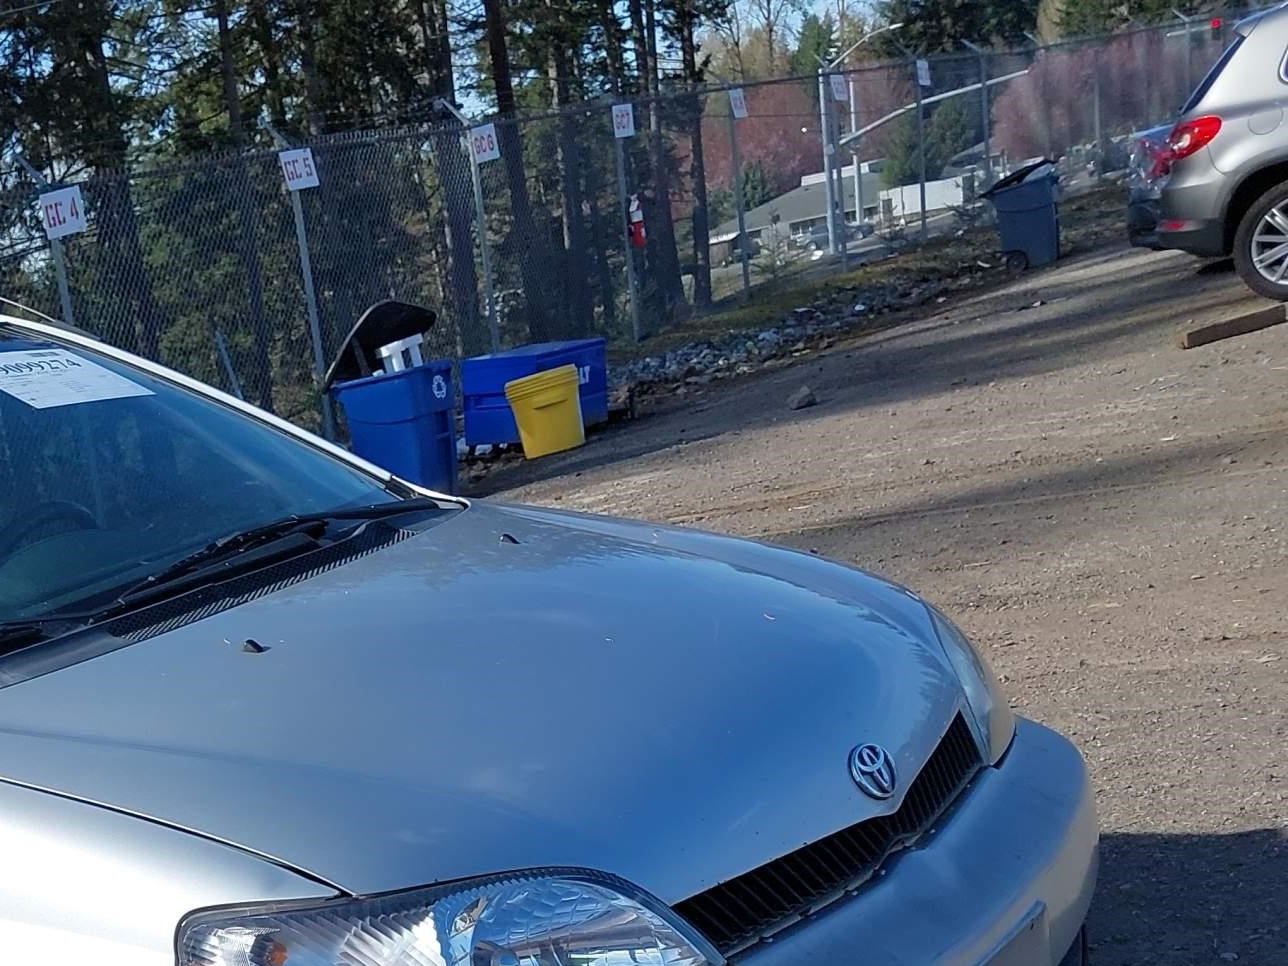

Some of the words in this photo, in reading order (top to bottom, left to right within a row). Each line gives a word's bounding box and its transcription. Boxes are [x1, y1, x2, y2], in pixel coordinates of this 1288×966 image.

[474, 133, 494, 154] GC6
[284, 160, 303, 181] GC
[303, 157, 313, 177] 5
[45, 201, 66, 228] GC
[70, 196, 79, 220] 4
